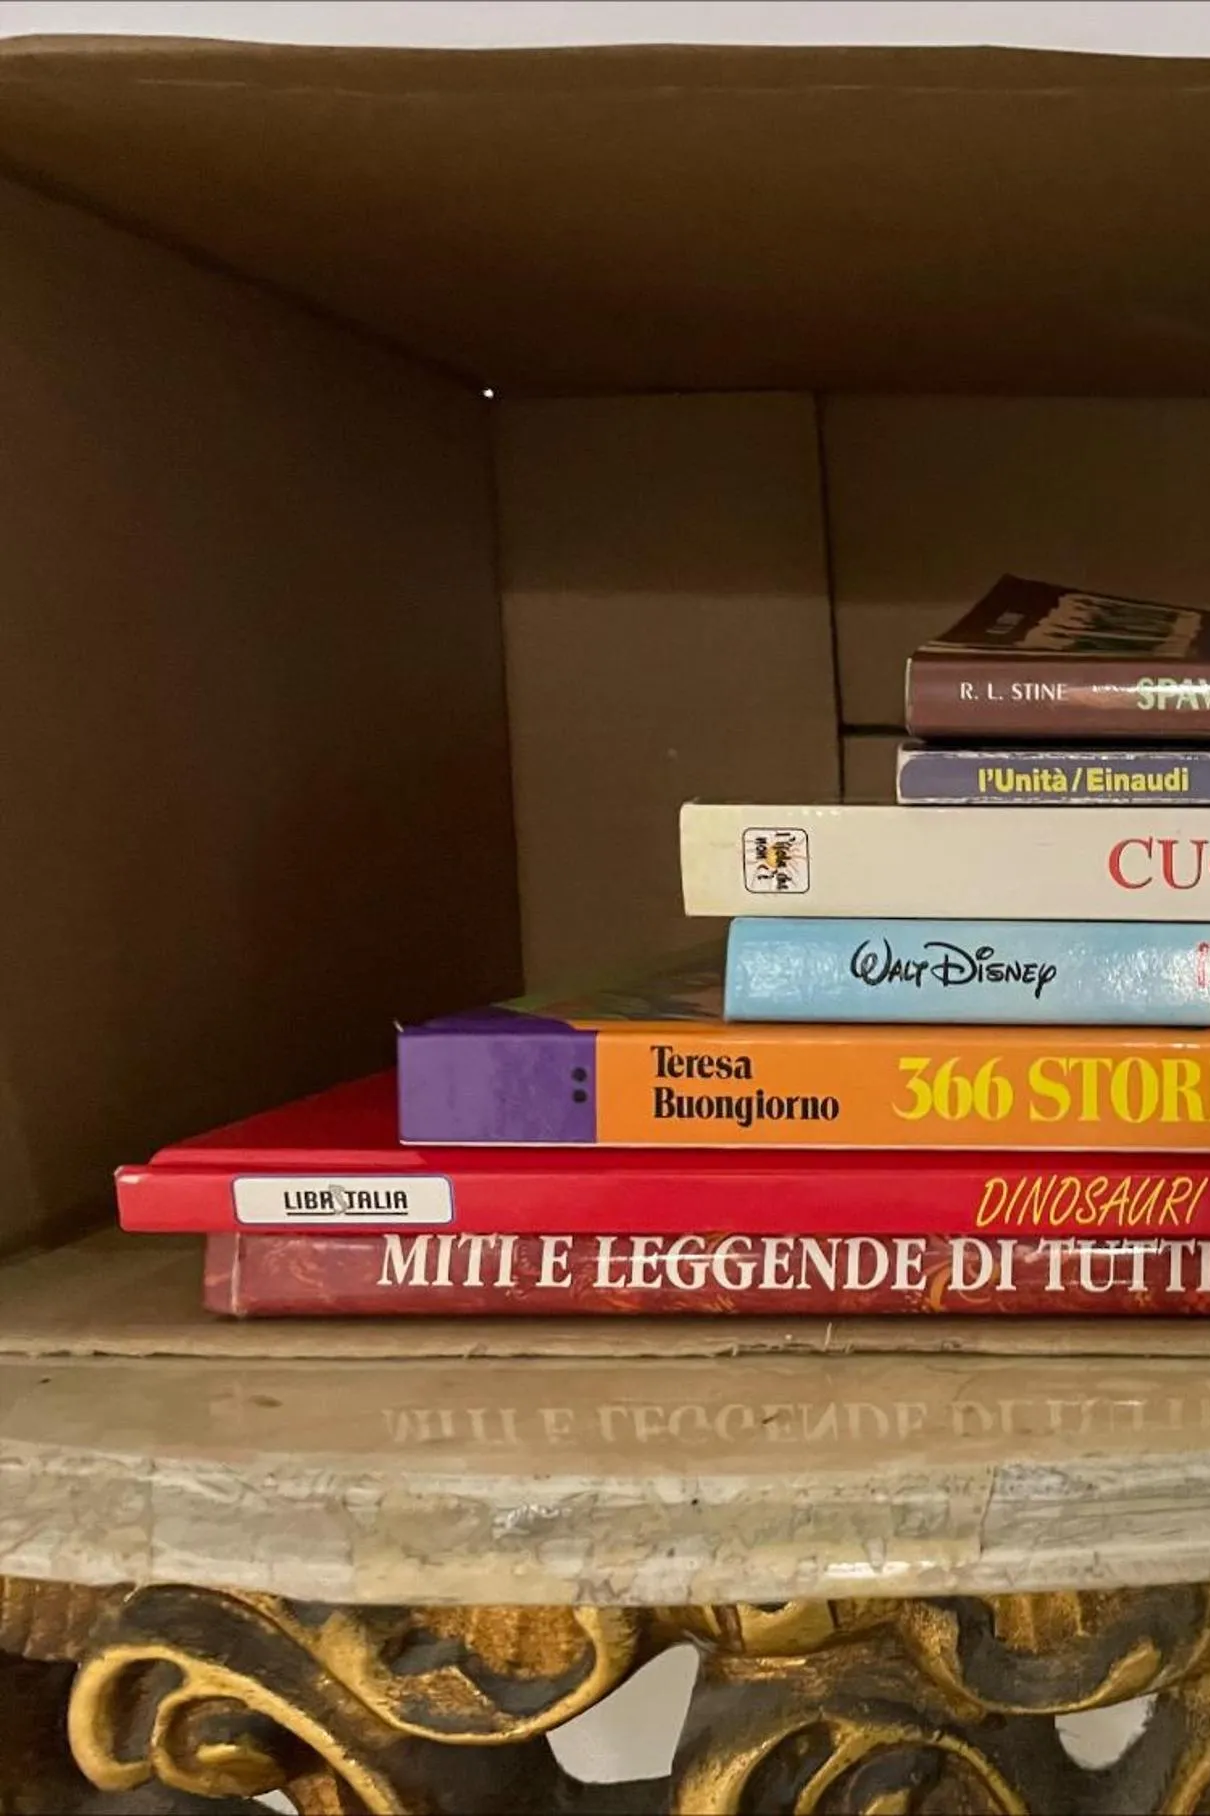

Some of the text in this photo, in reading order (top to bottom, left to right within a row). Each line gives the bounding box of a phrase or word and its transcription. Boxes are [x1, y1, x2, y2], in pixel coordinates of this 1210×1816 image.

[960, 681, 1069, 701] R. L. STINE
[651, 1045, 753, 1081] Teresa
[653, 1086, 840, 1129] Buongiorno
[894, 1056, 1013, 1123] 366
[975, 1175, 1209, 1228] DINOSAURI
[376, 1233, 516, 1288] MITI
[538, 1234, 573, 1288] E
[592, 1236, 926, 1292] LEGGENDE
[948, 1238, 1016, 1292] DI
